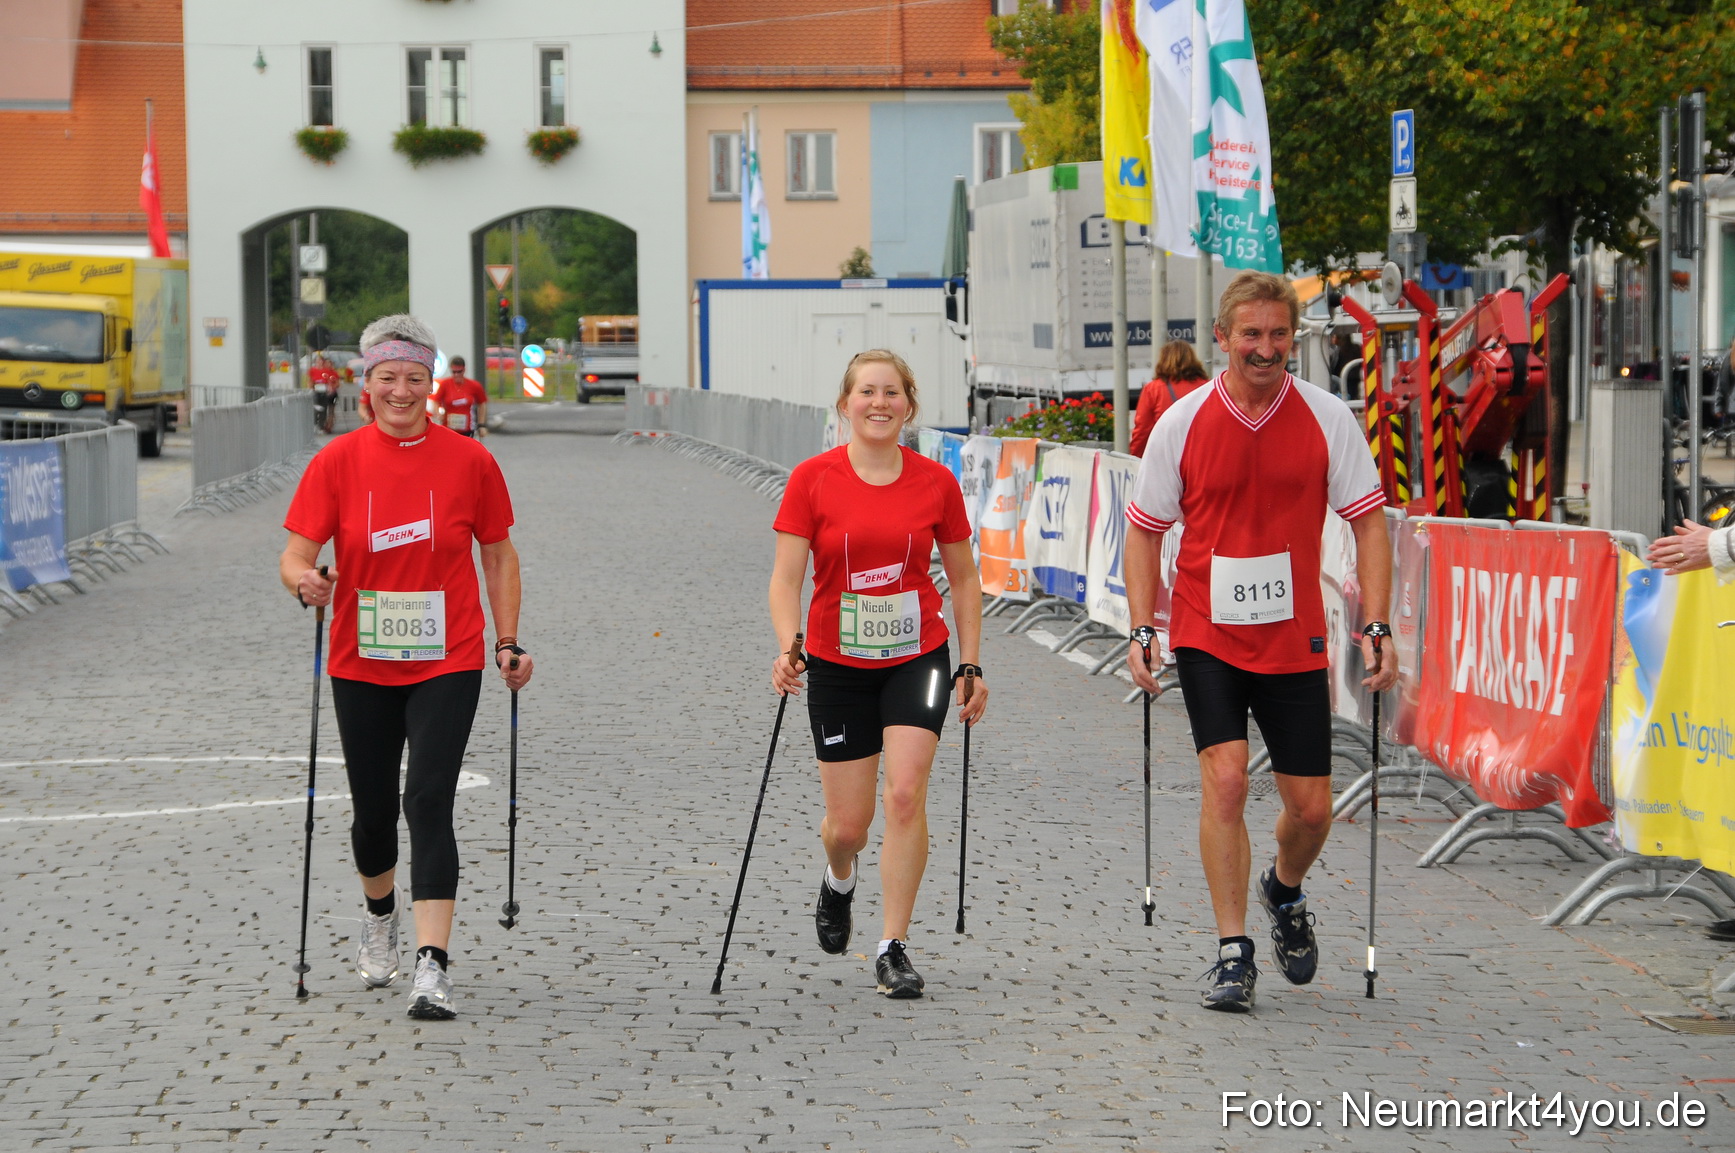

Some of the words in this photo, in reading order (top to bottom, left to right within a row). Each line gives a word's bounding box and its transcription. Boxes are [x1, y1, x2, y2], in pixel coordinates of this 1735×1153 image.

[1397, 119, 1409, 166] P
[388, 529, 414, 542] DEHN
[865, 572, 889, 583] DEHN
[1234, 580, 1285, 602] 8113
[380, 596, 431, 610] Marianne
[861, 600, 893, 613] Nicole
[382, 618, 436, 637] 8083
[863, 617, 914, 637] 8088
[1632, 799, 1672, 814] Palisaden
